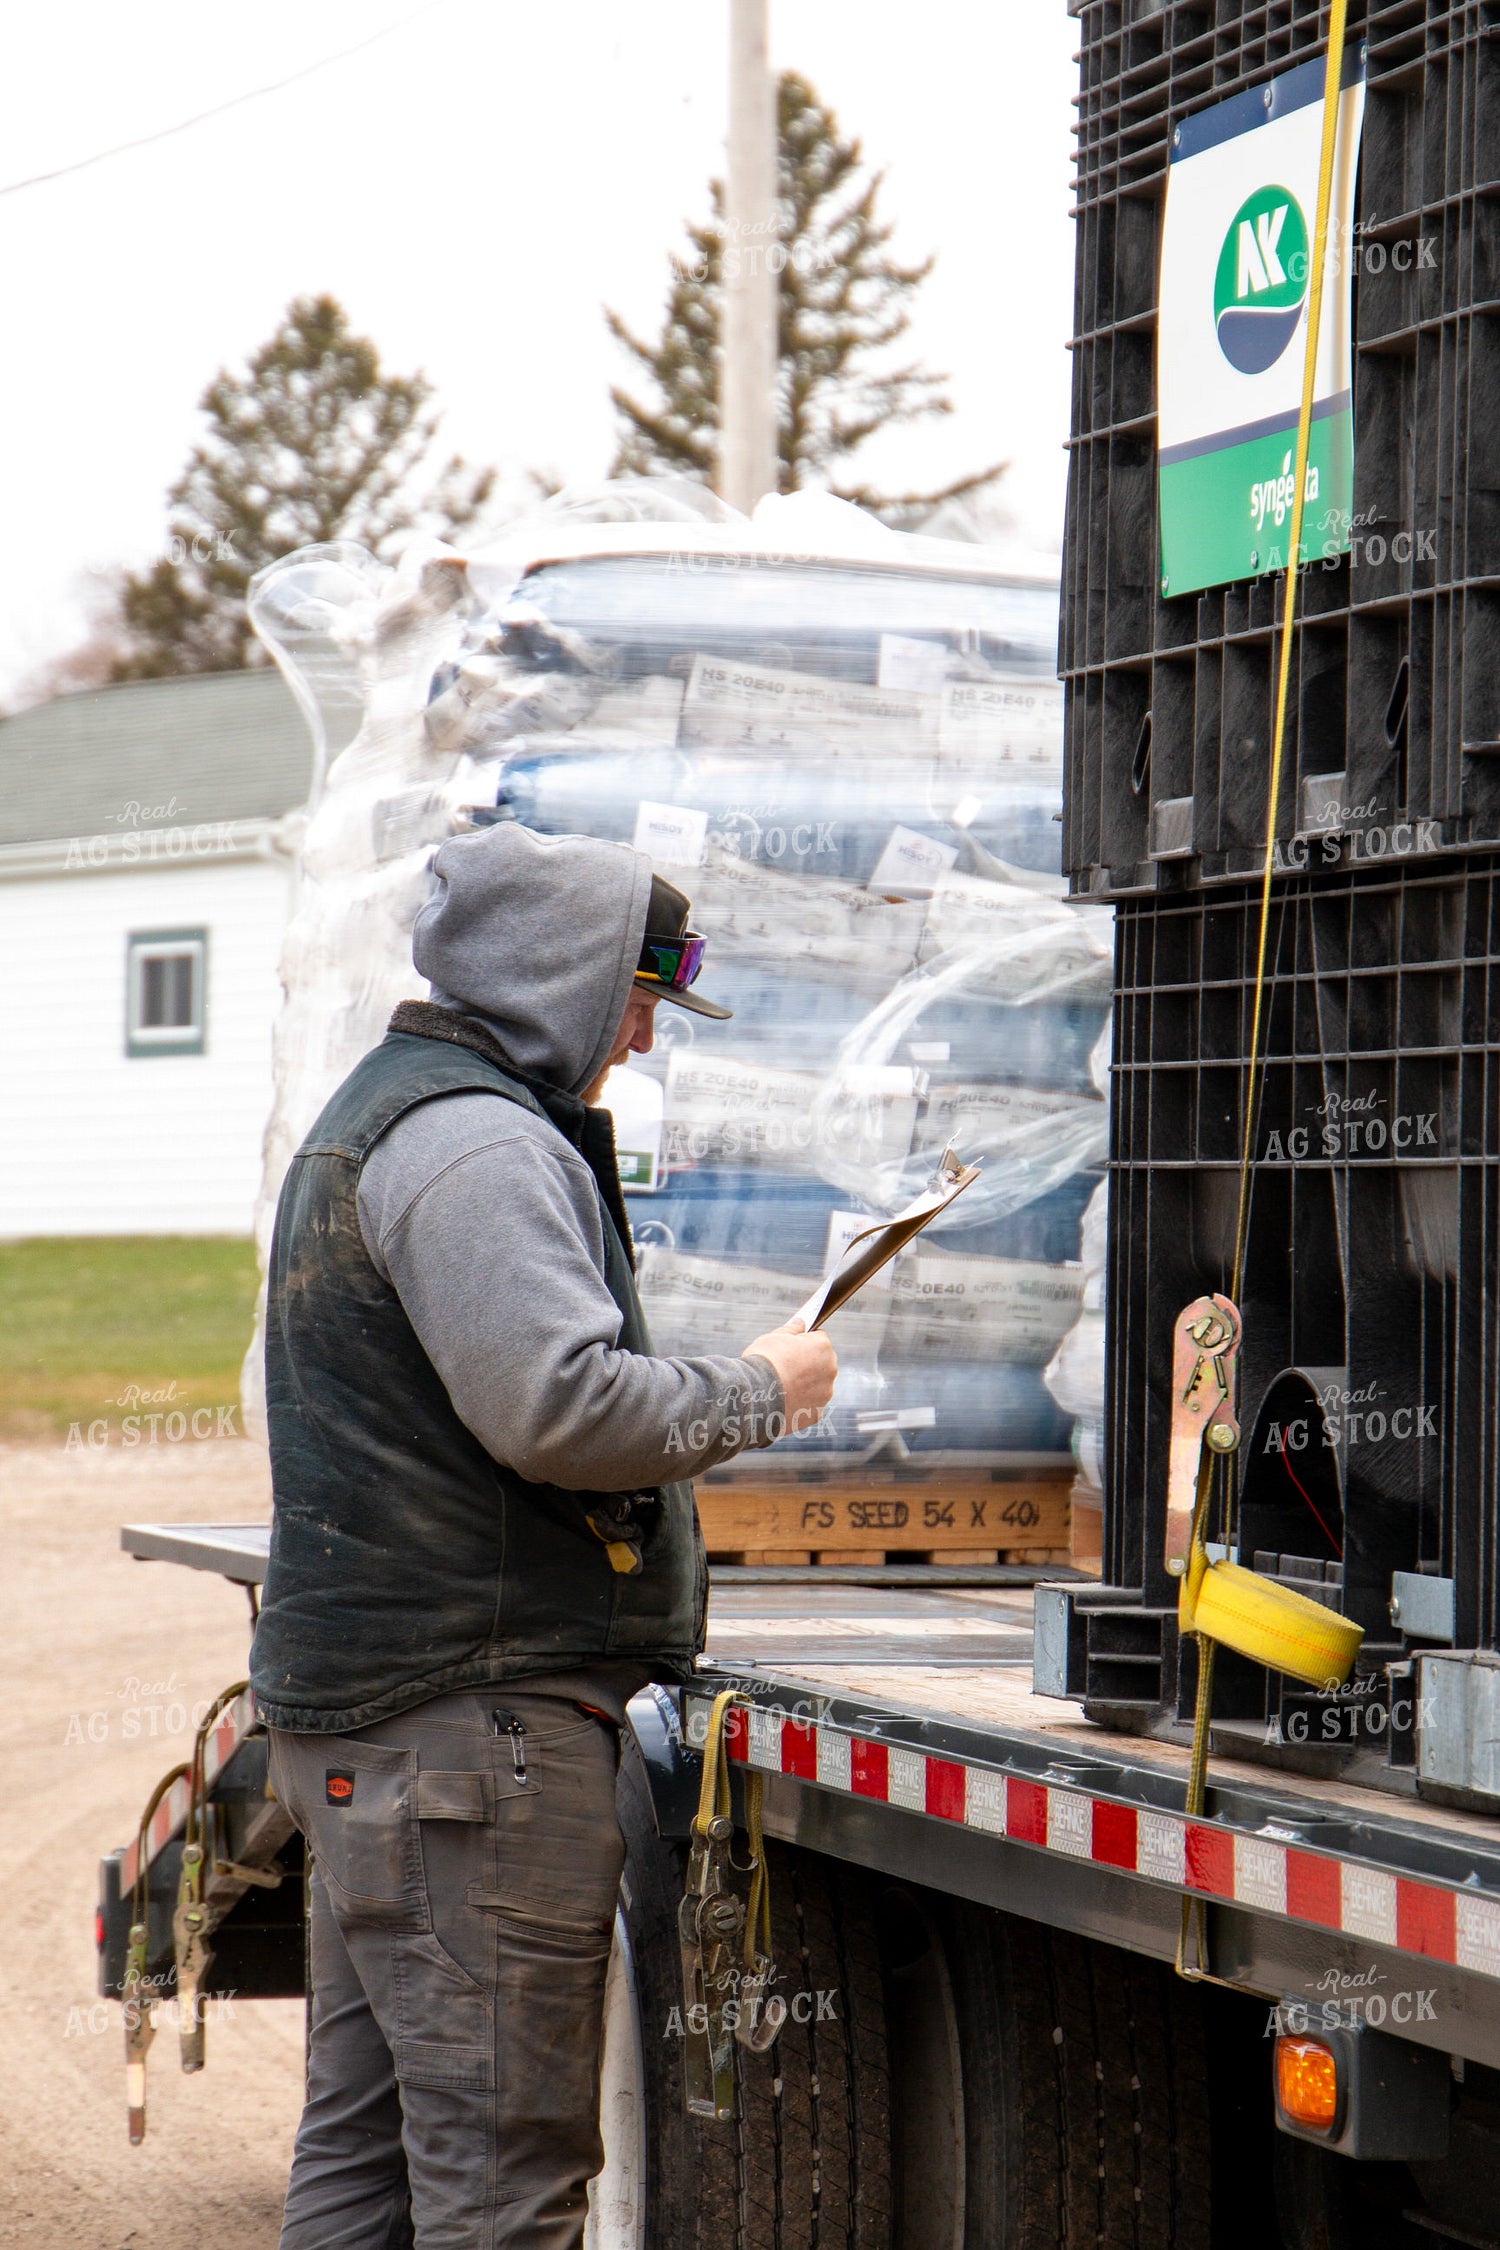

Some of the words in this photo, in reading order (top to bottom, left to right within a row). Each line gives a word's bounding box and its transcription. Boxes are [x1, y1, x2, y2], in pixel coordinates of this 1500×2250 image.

[1250, 460, 1319, 531] syngeta
[704, 1072, 759, 1090] 20E40
[670, 1272, 724, 1292] 20E40
[915, 1283, 966, 1294] 0E40
[802, 1501, 836, 1528] FS
[847, 1501, 909, 1528] SEED
[923, 1501, 956, 1528] 54
[971, 1501, 988, 1528] X
